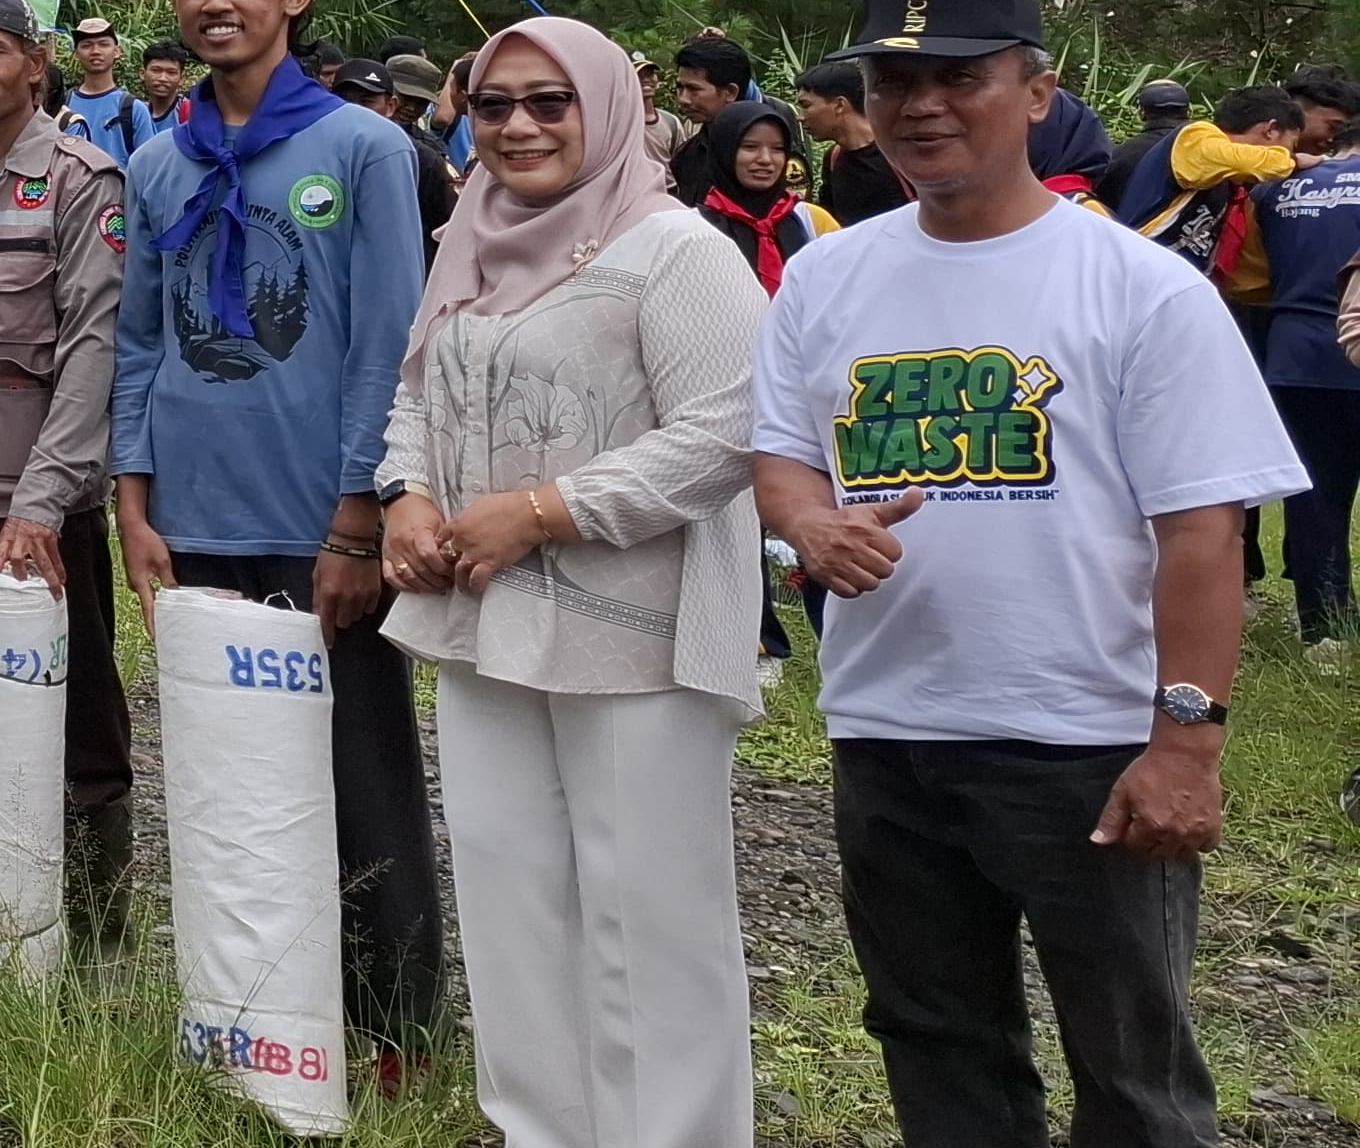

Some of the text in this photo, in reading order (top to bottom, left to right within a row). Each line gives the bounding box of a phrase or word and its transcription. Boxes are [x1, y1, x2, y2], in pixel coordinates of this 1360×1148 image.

[274, 215, 304, 252] ALAM
[856, 354, 1011, 417] ZERO
[835, 412, 1035, 476] WASTE
[940, 489, 1003, 502] INDONESIA
[225, 644, 323, 693] 535R
